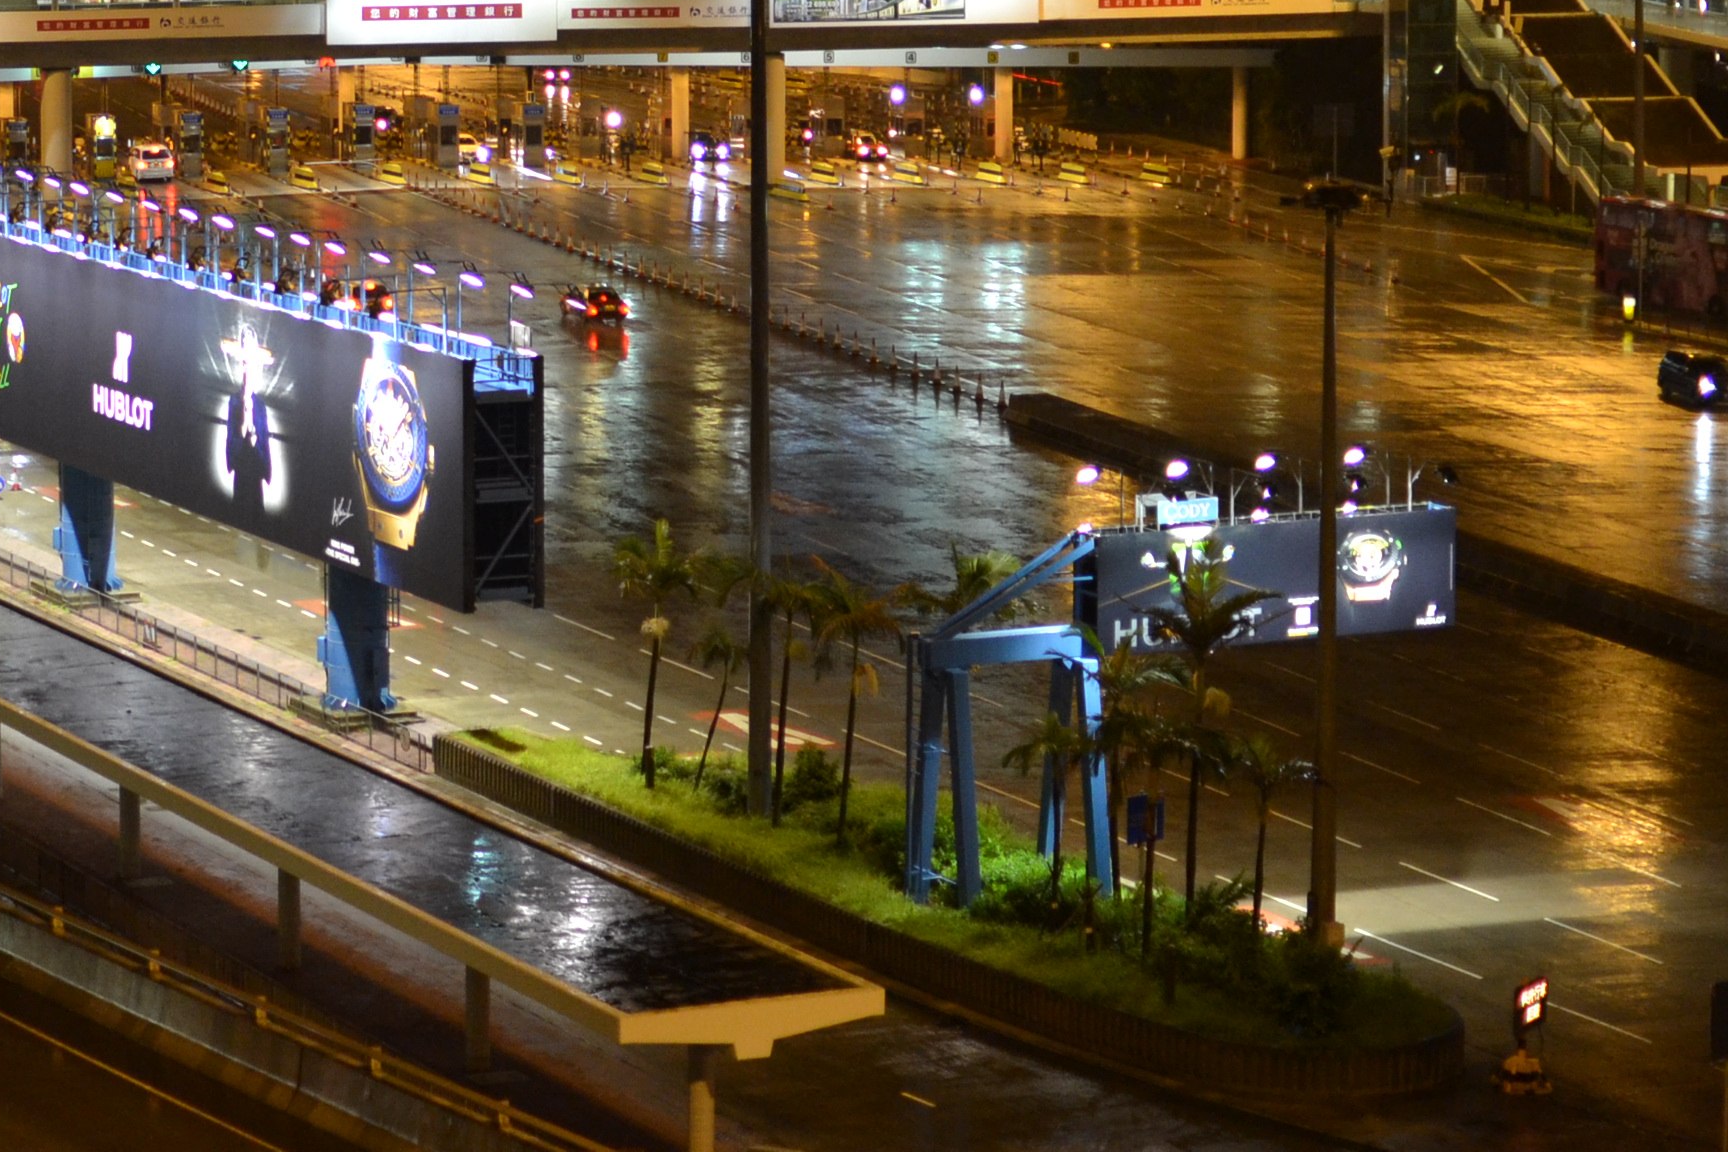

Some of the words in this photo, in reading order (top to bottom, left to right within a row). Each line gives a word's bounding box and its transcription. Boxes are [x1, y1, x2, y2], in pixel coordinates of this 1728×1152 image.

[370, 5, 514, 19] 您的財富管理銀行
[93, 383, 153, 431] HUBLOT
[1164, 502, 1211, 520] CODY
